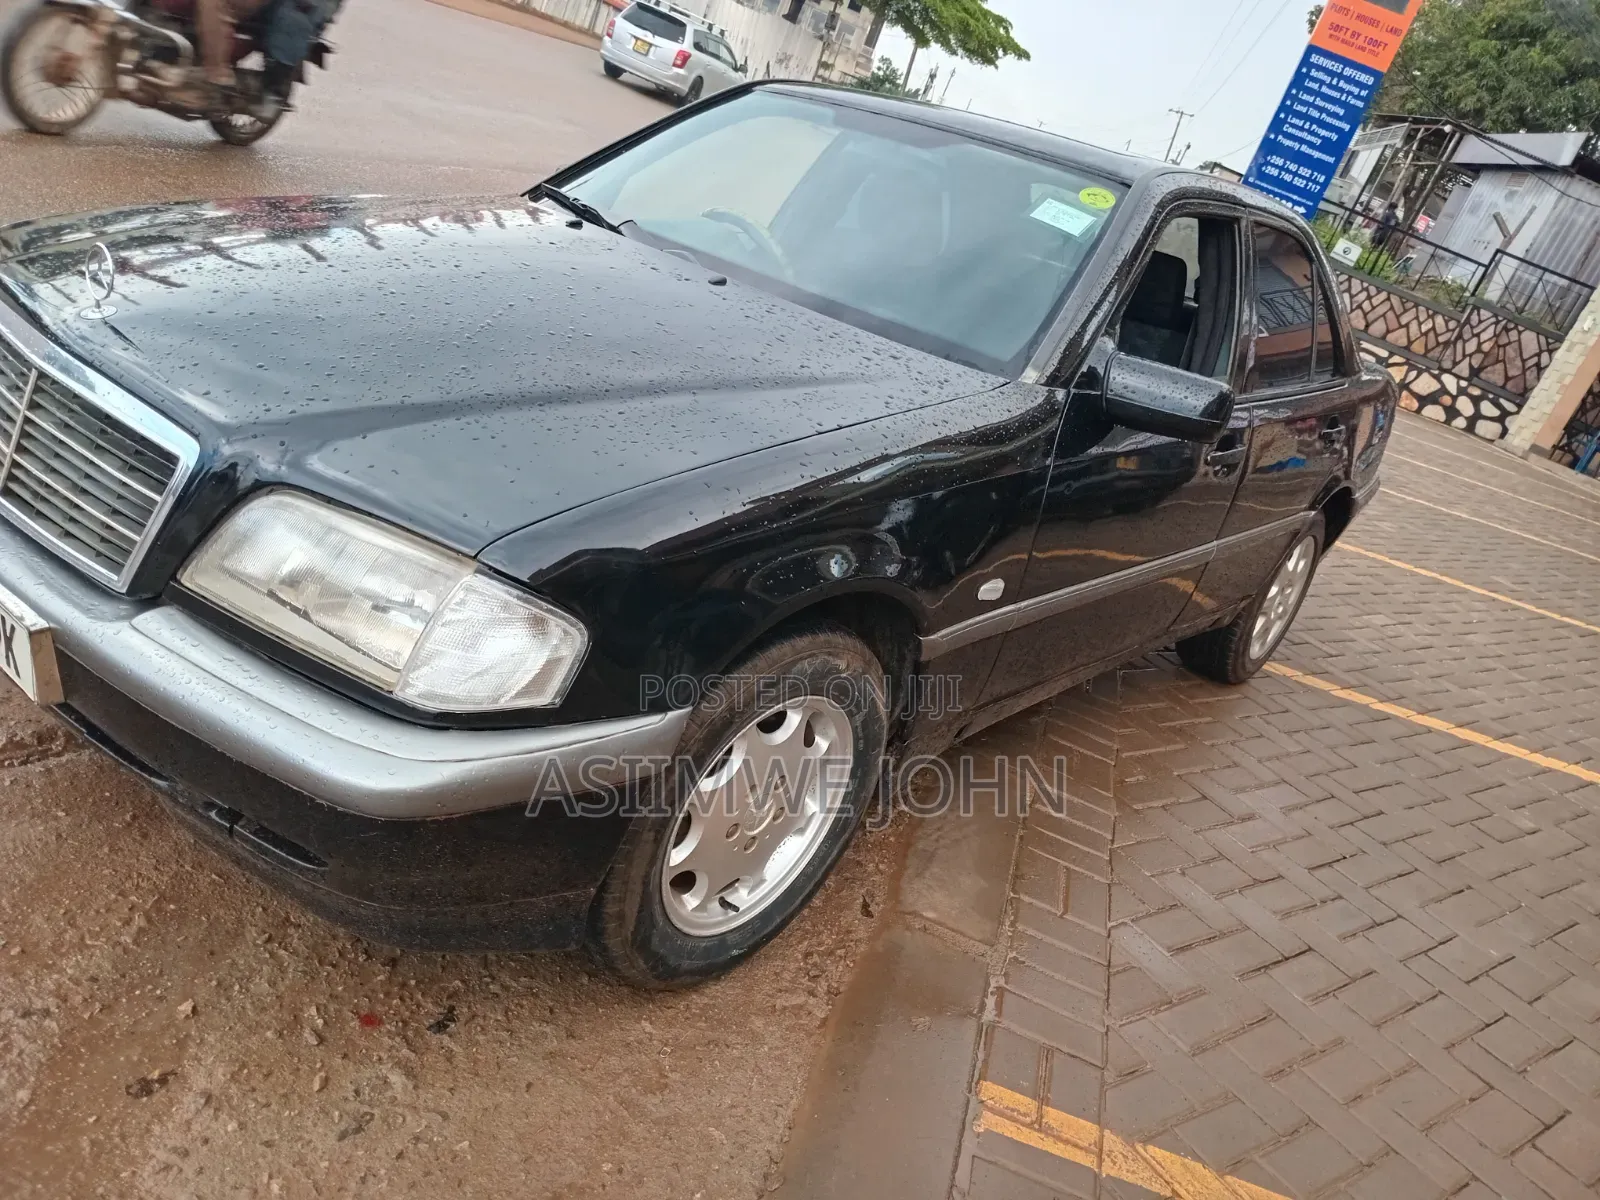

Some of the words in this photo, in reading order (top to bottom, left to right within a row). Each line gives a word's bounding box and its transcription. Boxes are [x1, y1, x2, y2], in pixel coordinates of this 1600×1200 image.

[1330, 3, 1351, 16] PLOTS
[1355, 13, 1380, 28] HOUSES
[1385, 25, 1403, 37] LAND
[1328, 22, 1350, 35] 50FT
[1350, 30, 1362, 40] BY
[1363, 35, 1388, 51] 100FT
[1309, 53, 1343, 73] SERVICES
[1343, 67, 1375, 85] OFFERED
[1310, 69, 1332, 84] Selling
[1331, 77, 1339, 85] &
[1338, 80, 1360, 94] Buying
[1359, 89, 1369, 97] of
[1298, 90, 1315, 103] Land
[1315, 97, 1345, 116] Surveying
[1304, 79, 1320, 91] Land,
[1320, 84, 1341, 99] Houses
[1340, 93, 1347, 101] &
[1346, 96, 1365, 108] Farms
[1287, 114, 1305, 127] Land
[1303, 121, 1311, 129] &
[1310, 124, 1339, 142] Property
[1292, 102, 1308, 113] Land
[1308, 107, 1321, 118] Title
[1320, 113, 1351, 131] Processing
[1282, 124, 1322, 145] Consultancy
[1276, 135, 1300, 151] Property
[1299, 144, 1336, 164] Management
[1261, 165, 1280, 176] +256
[1279, 171, 1293, 182] 740
[1292, 176, 1307, 187] 522
[1306, 182, 1321, 193] 717
[1266, 155, 1285, 166] +256
[1284, 161, 1299, 172] 740
[1297, 166, 1312, 177] 522
[1311, 171, 1326, 183] 718
[0, 612, 21, 679] K
